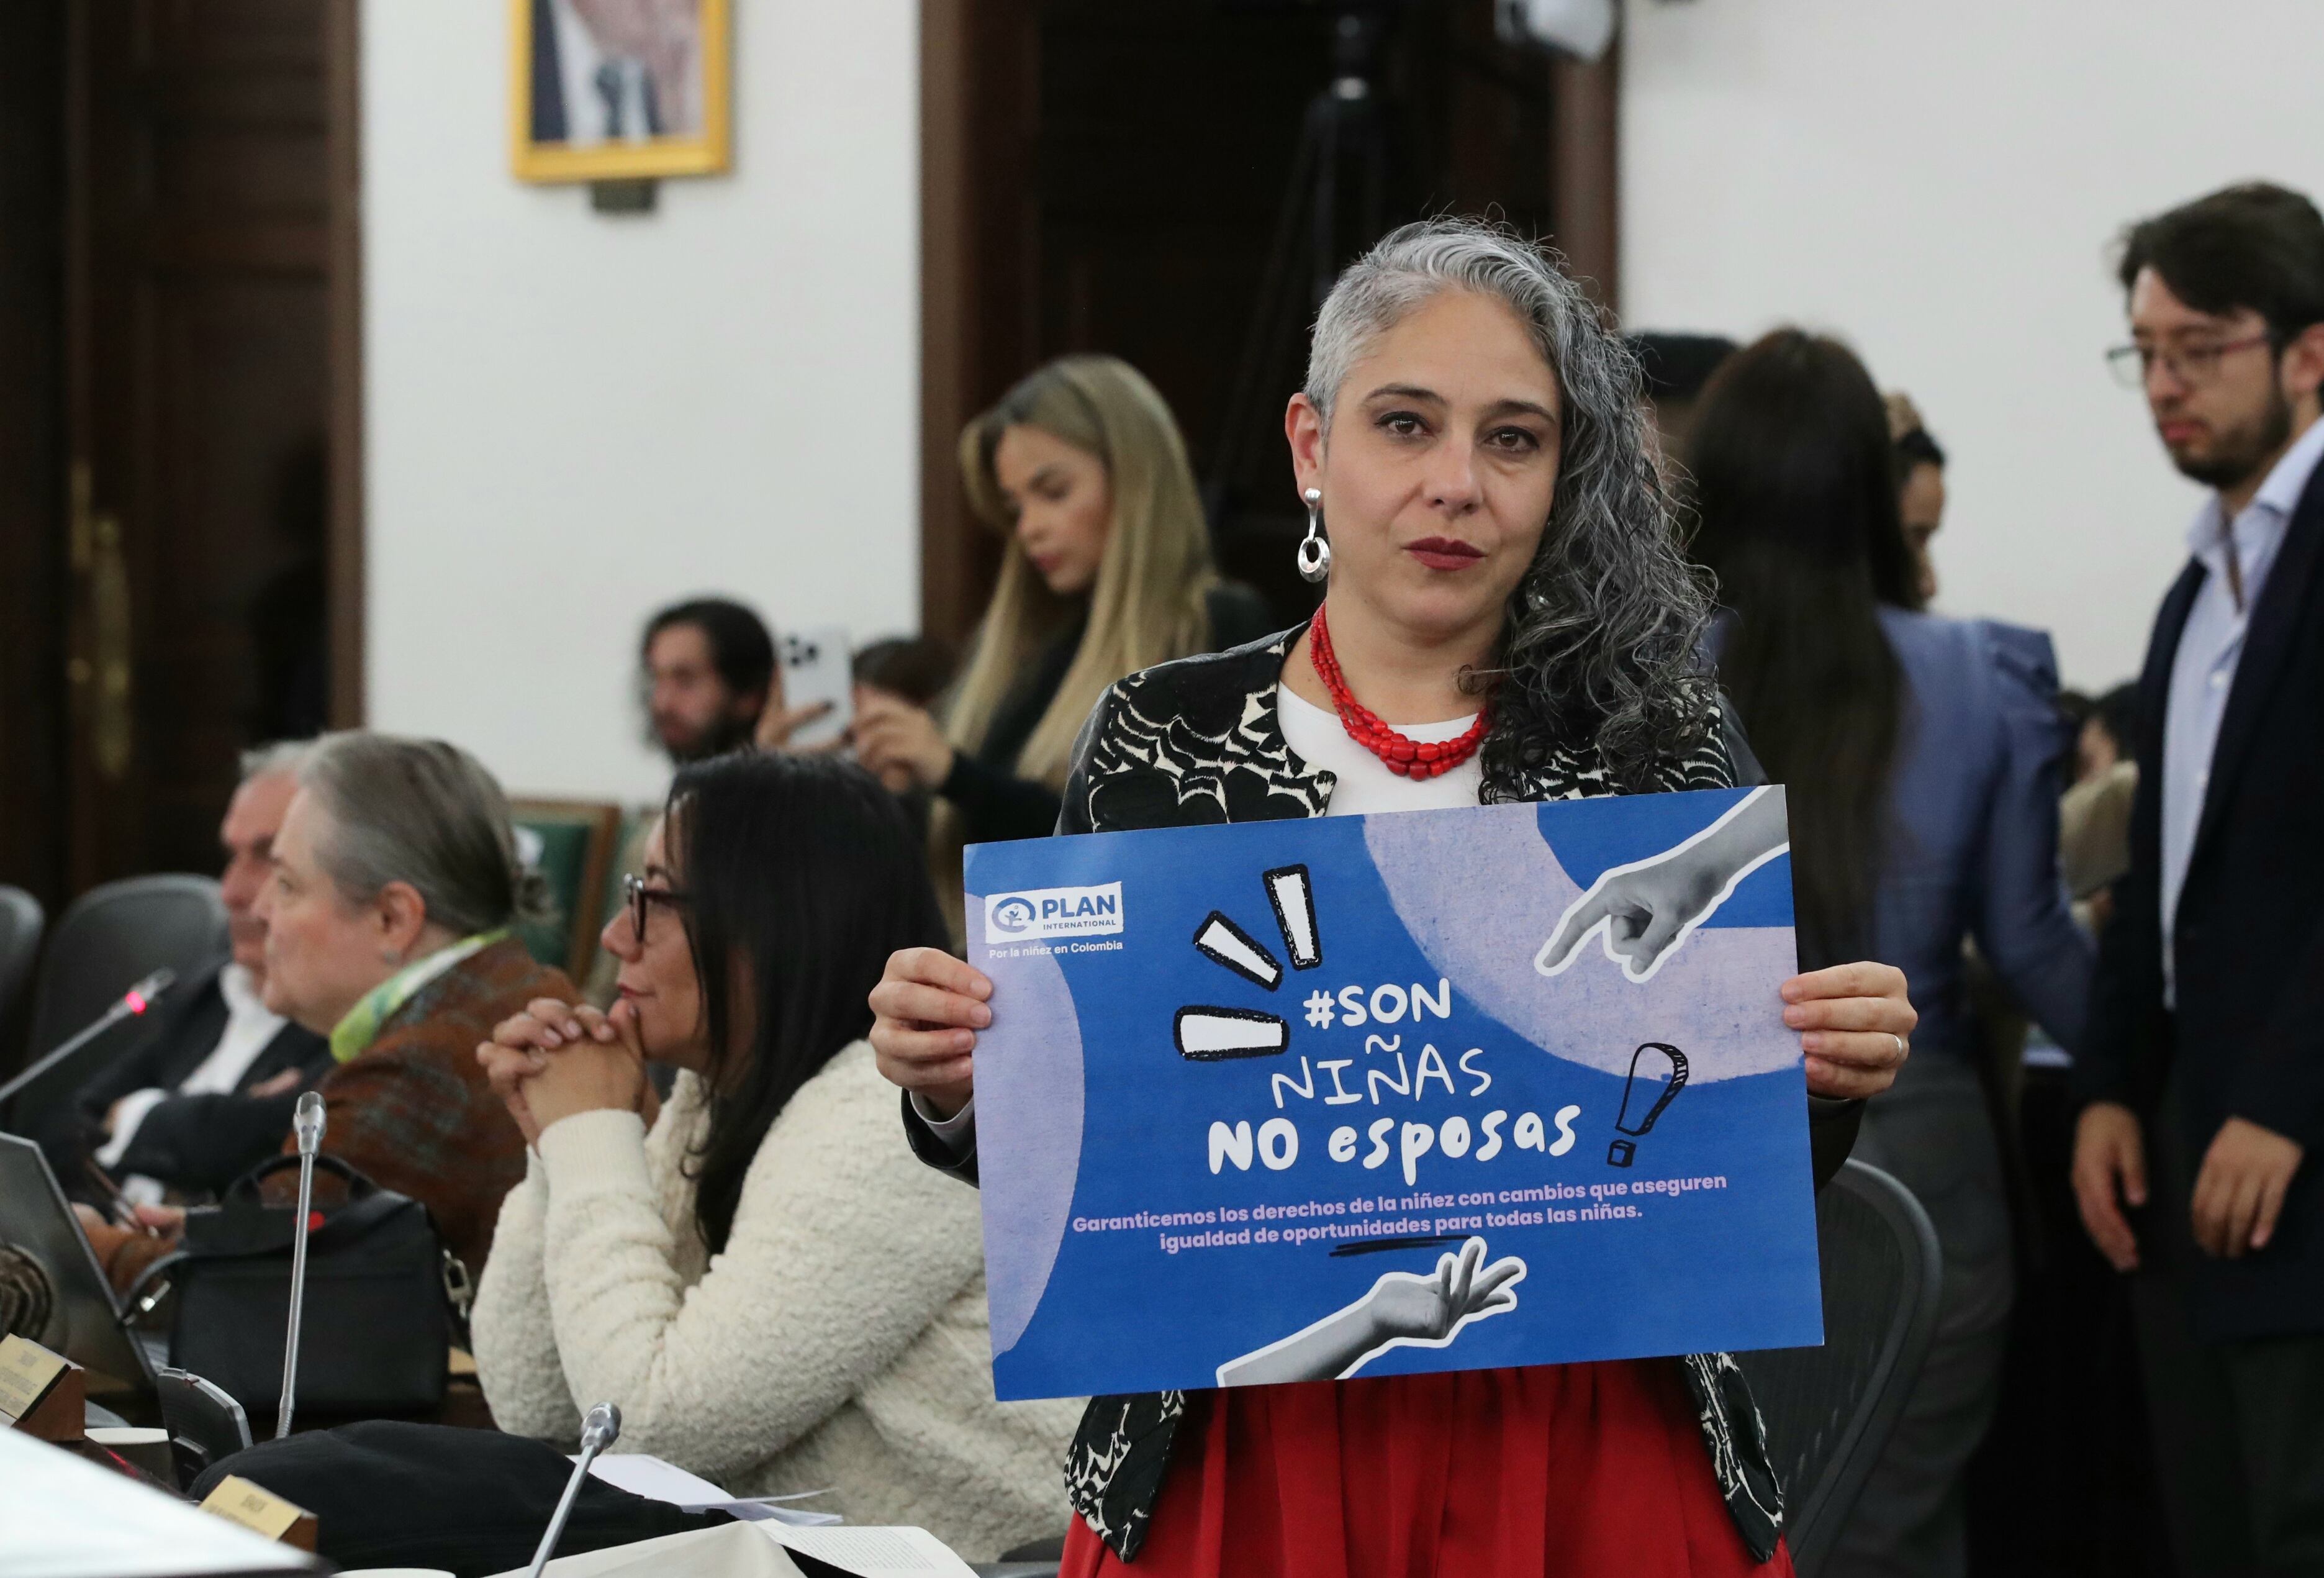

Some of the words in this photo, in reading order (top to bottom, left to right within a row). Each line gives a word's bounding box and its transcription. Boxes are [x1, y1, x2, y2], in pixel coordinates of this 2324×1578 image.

[1042, 894, 1116, 919] PLAN
[1043, 919, 1116, 930] INTERNATIONAL
[989, 949, 1008, 959] Por
[1010, 947, 1020, 958] la
[1023, 945, 1051, 956] niñez
[1055, 945, 1068, 954] en
[1070, 940, 1123, 953] Colombia
[1303, 977, 1451, 1029] #SON
[1271, 1033, 1491, 1109] NIÑAS
[1208, 1117, 1299, 1175] NO
[1328, 1104, 1581, 1187] esposas
[1073, 1208, 1216, 1232] Garanticemos
[1220, 1207, 1249, 1223] los
[1252, 1199, 1345, 1221] derechos
[1349, 1197, 1374, 1213] de
[1378, 1195, 1396, 1211] la
[1401, 1191, 1454, 1211] niñez
[1458, 1192, 1494, 1207] con
[1498, 1182, 1586, 1203] cambios
[1589, 1182, 1628, 1202] que
[1631, 1174, 1727, 1197] aseguren
[1159, 1227, 1250, 1254] igualdad
[1254, 1226, 1279, 1243] de
[1282, 1213, 1431, 1246] oportunidades
[1435, 1215, 1482, 1236] para
[1485, 1209, 1544, 1227] todas
[1547, 1205, 1577, 1223] las
[1580, 1201, 1643, 1222] niñas.
